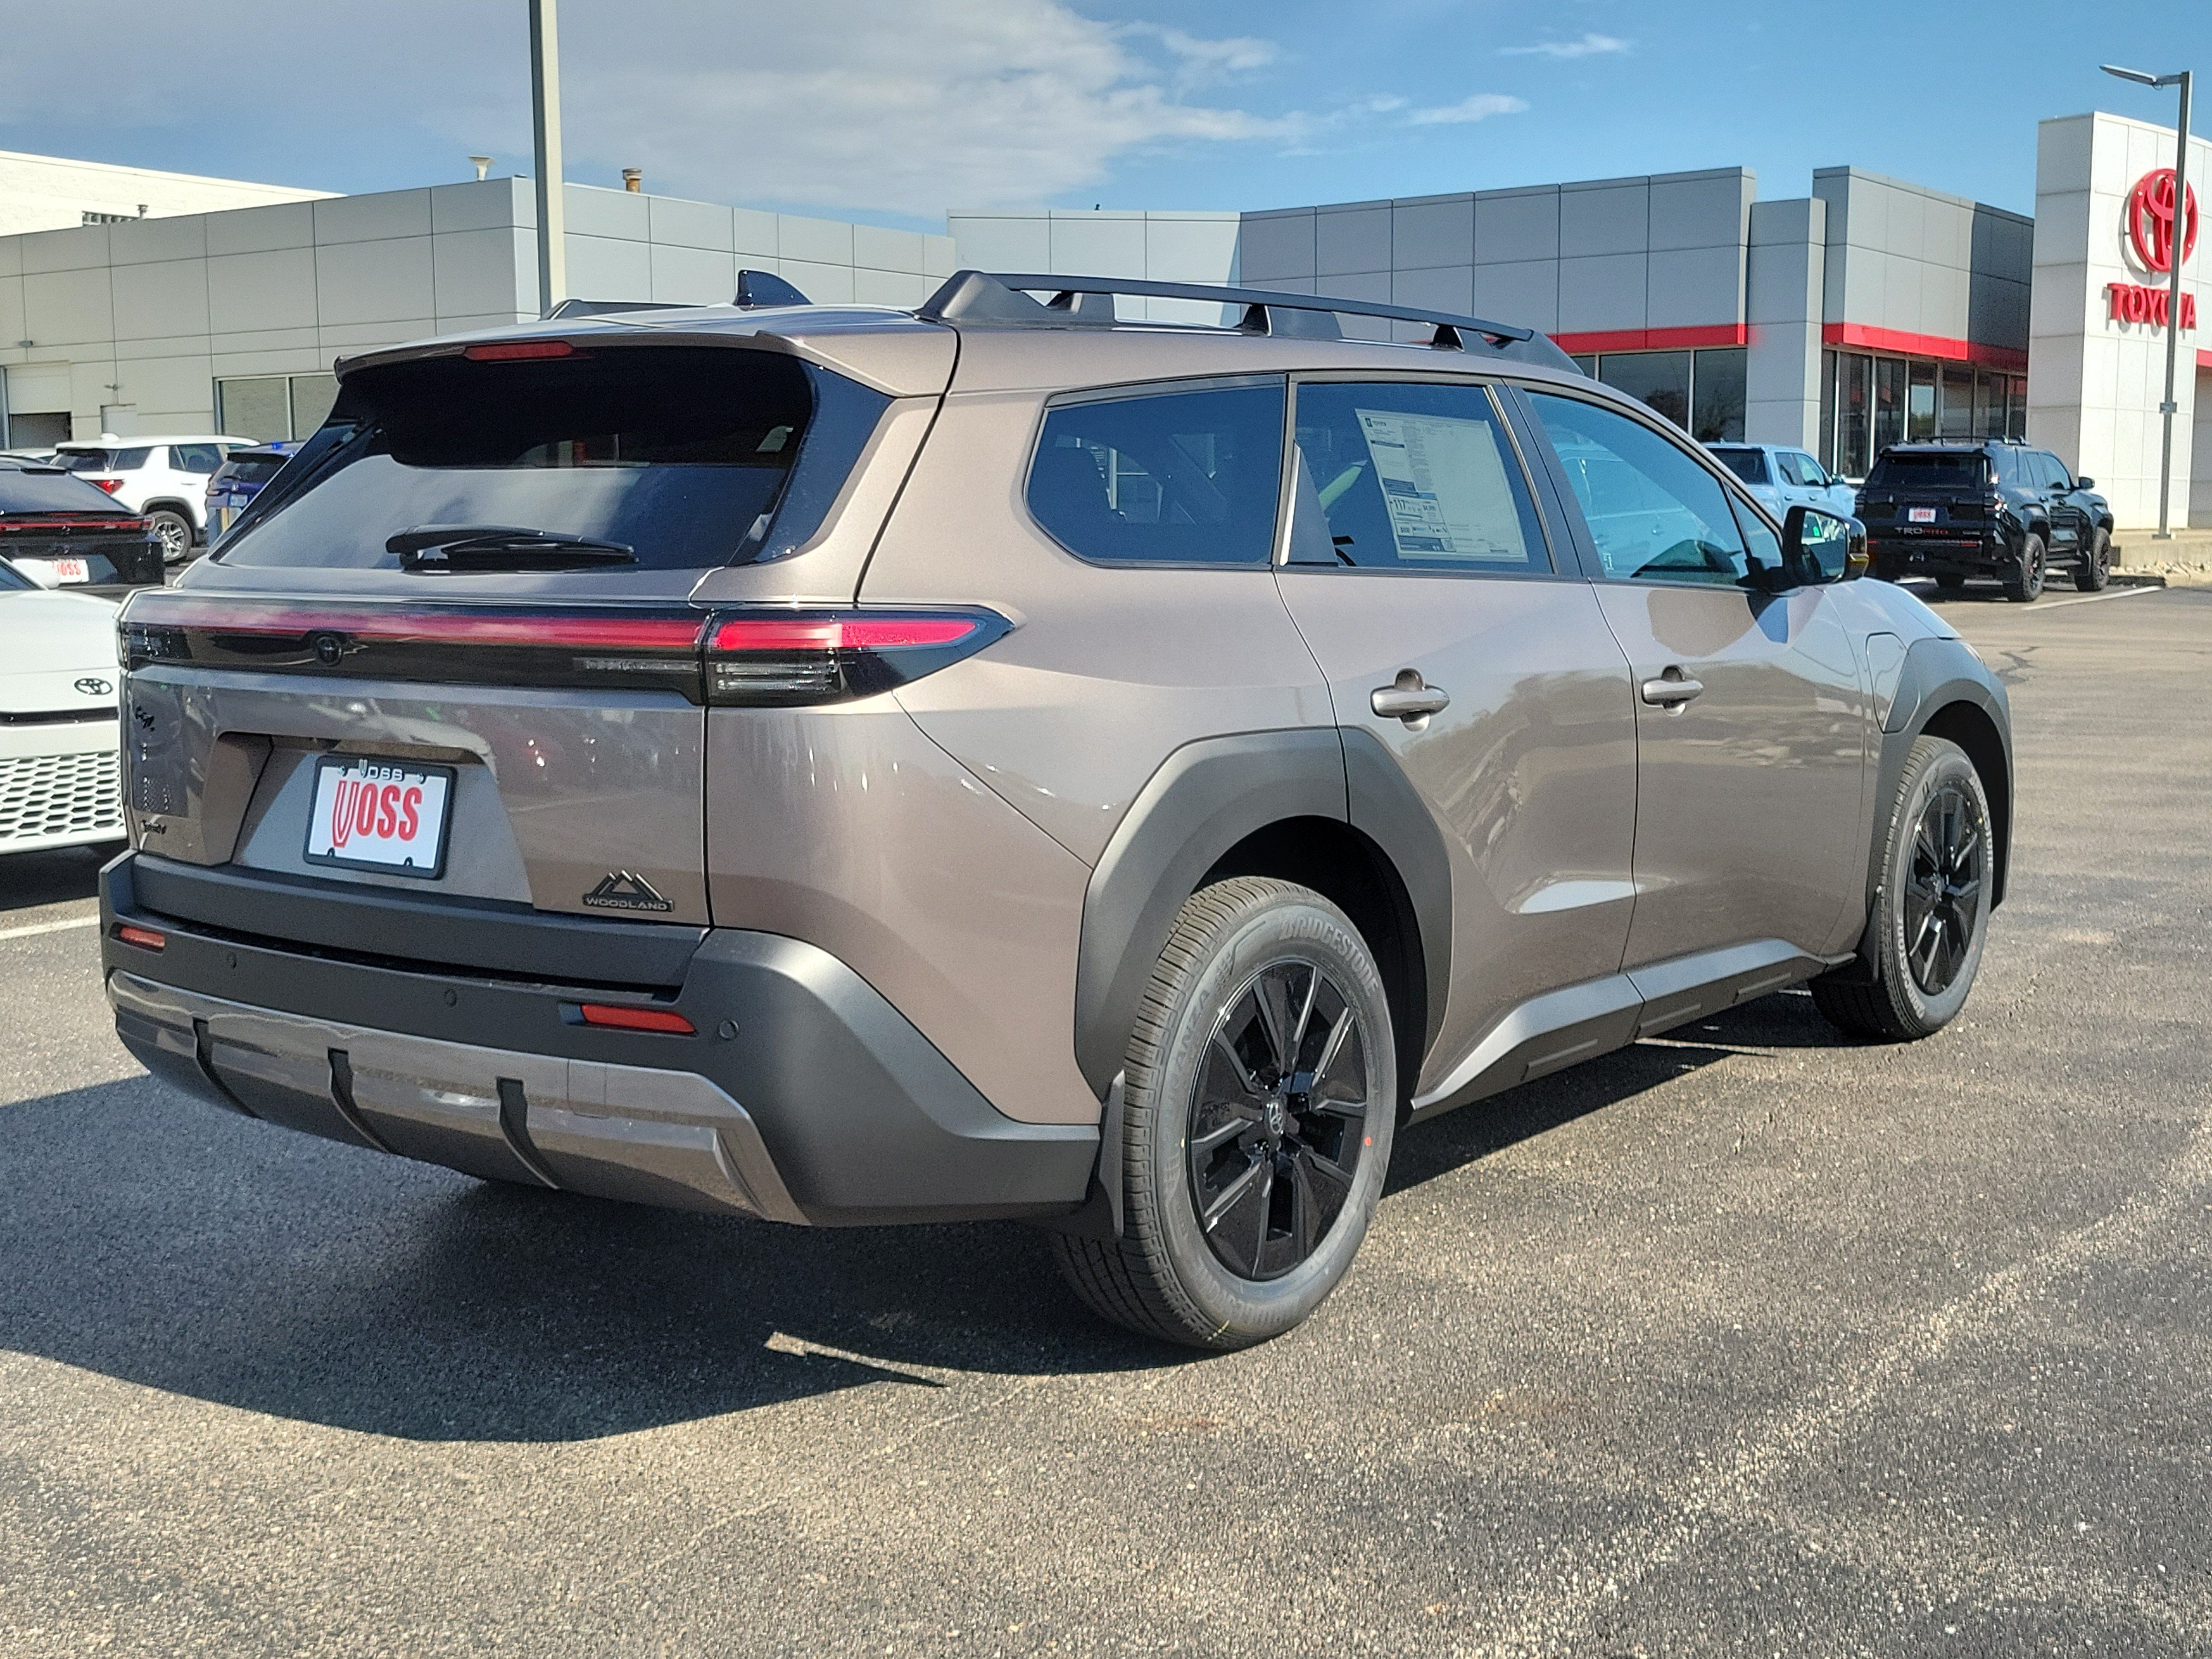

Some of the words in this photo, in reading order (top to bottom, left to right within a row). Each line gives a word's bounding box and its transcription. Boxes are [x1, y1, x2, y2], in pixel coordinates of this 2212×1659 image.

[1895, 527, 1923, 535] TRD
[358, 759, 404, 782] VOSS
[331, 780, 422, 848] VOSS
[586, 896, 668, 911] WOODLAND
[1278, 913, 1379, 997] BRIDGESTONE
